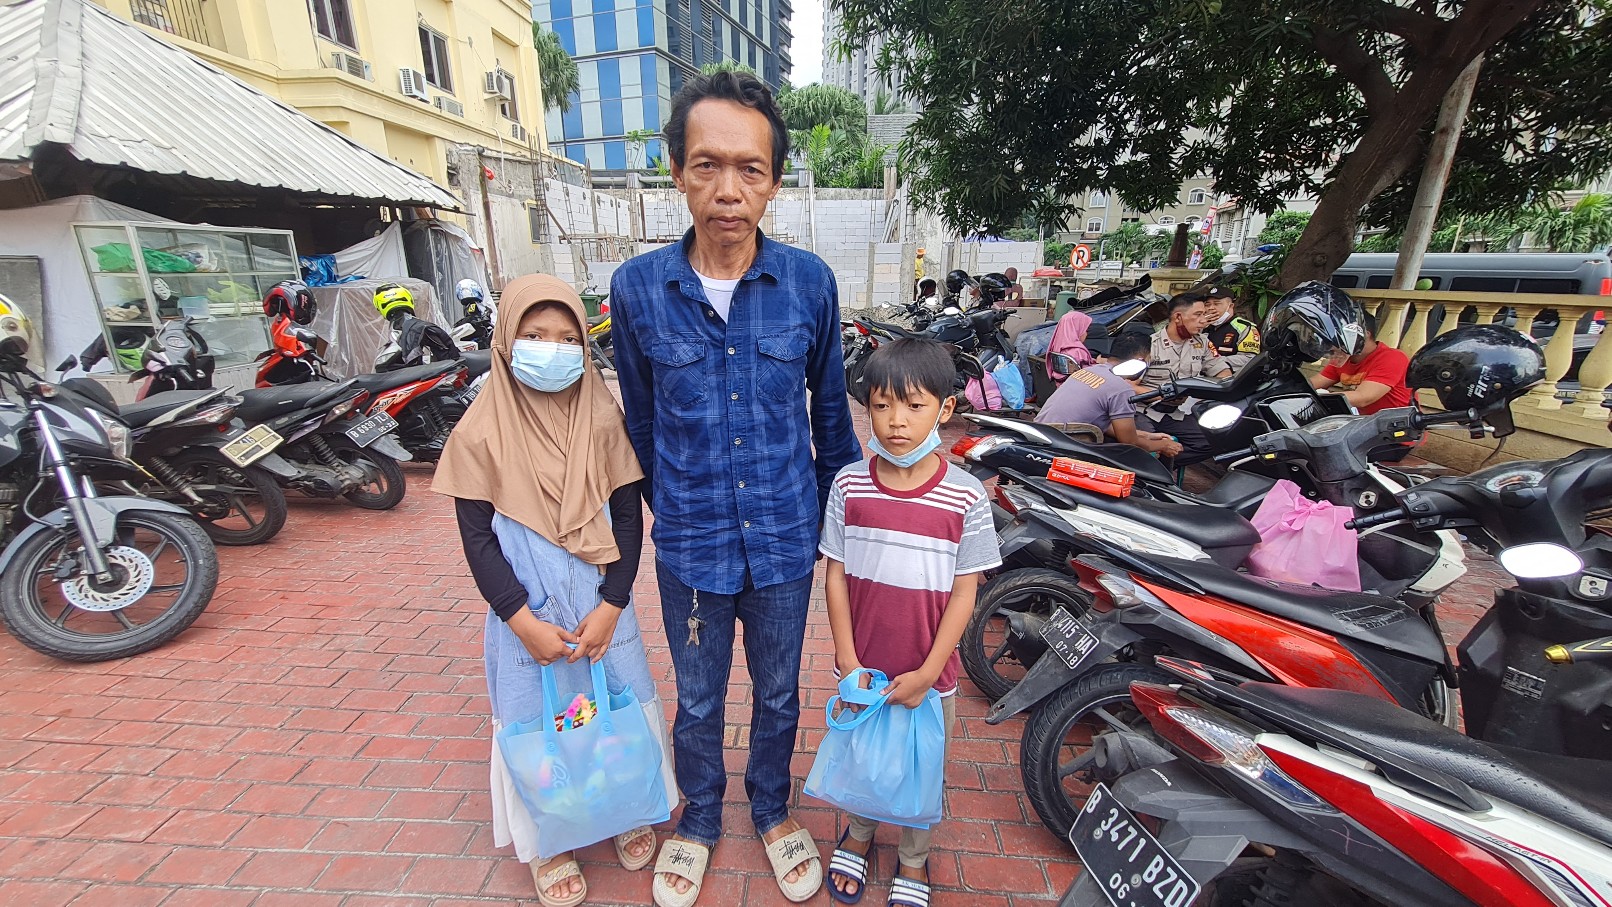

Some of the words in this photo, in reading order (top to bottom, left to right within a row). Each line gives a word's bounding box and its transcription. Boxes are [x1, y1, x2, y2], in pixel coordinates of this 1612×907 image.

[1076, 249, 1085, 265] P
[349, 430, 360, 438] B
[356, 420, 376, 434] 6930
[1074, 633, 1094, 655] HA
[1086, 789, 1102, 814] B
[1100, 807, 1147, 863] 3471
[1142, 854, 1189, 907] BZD
